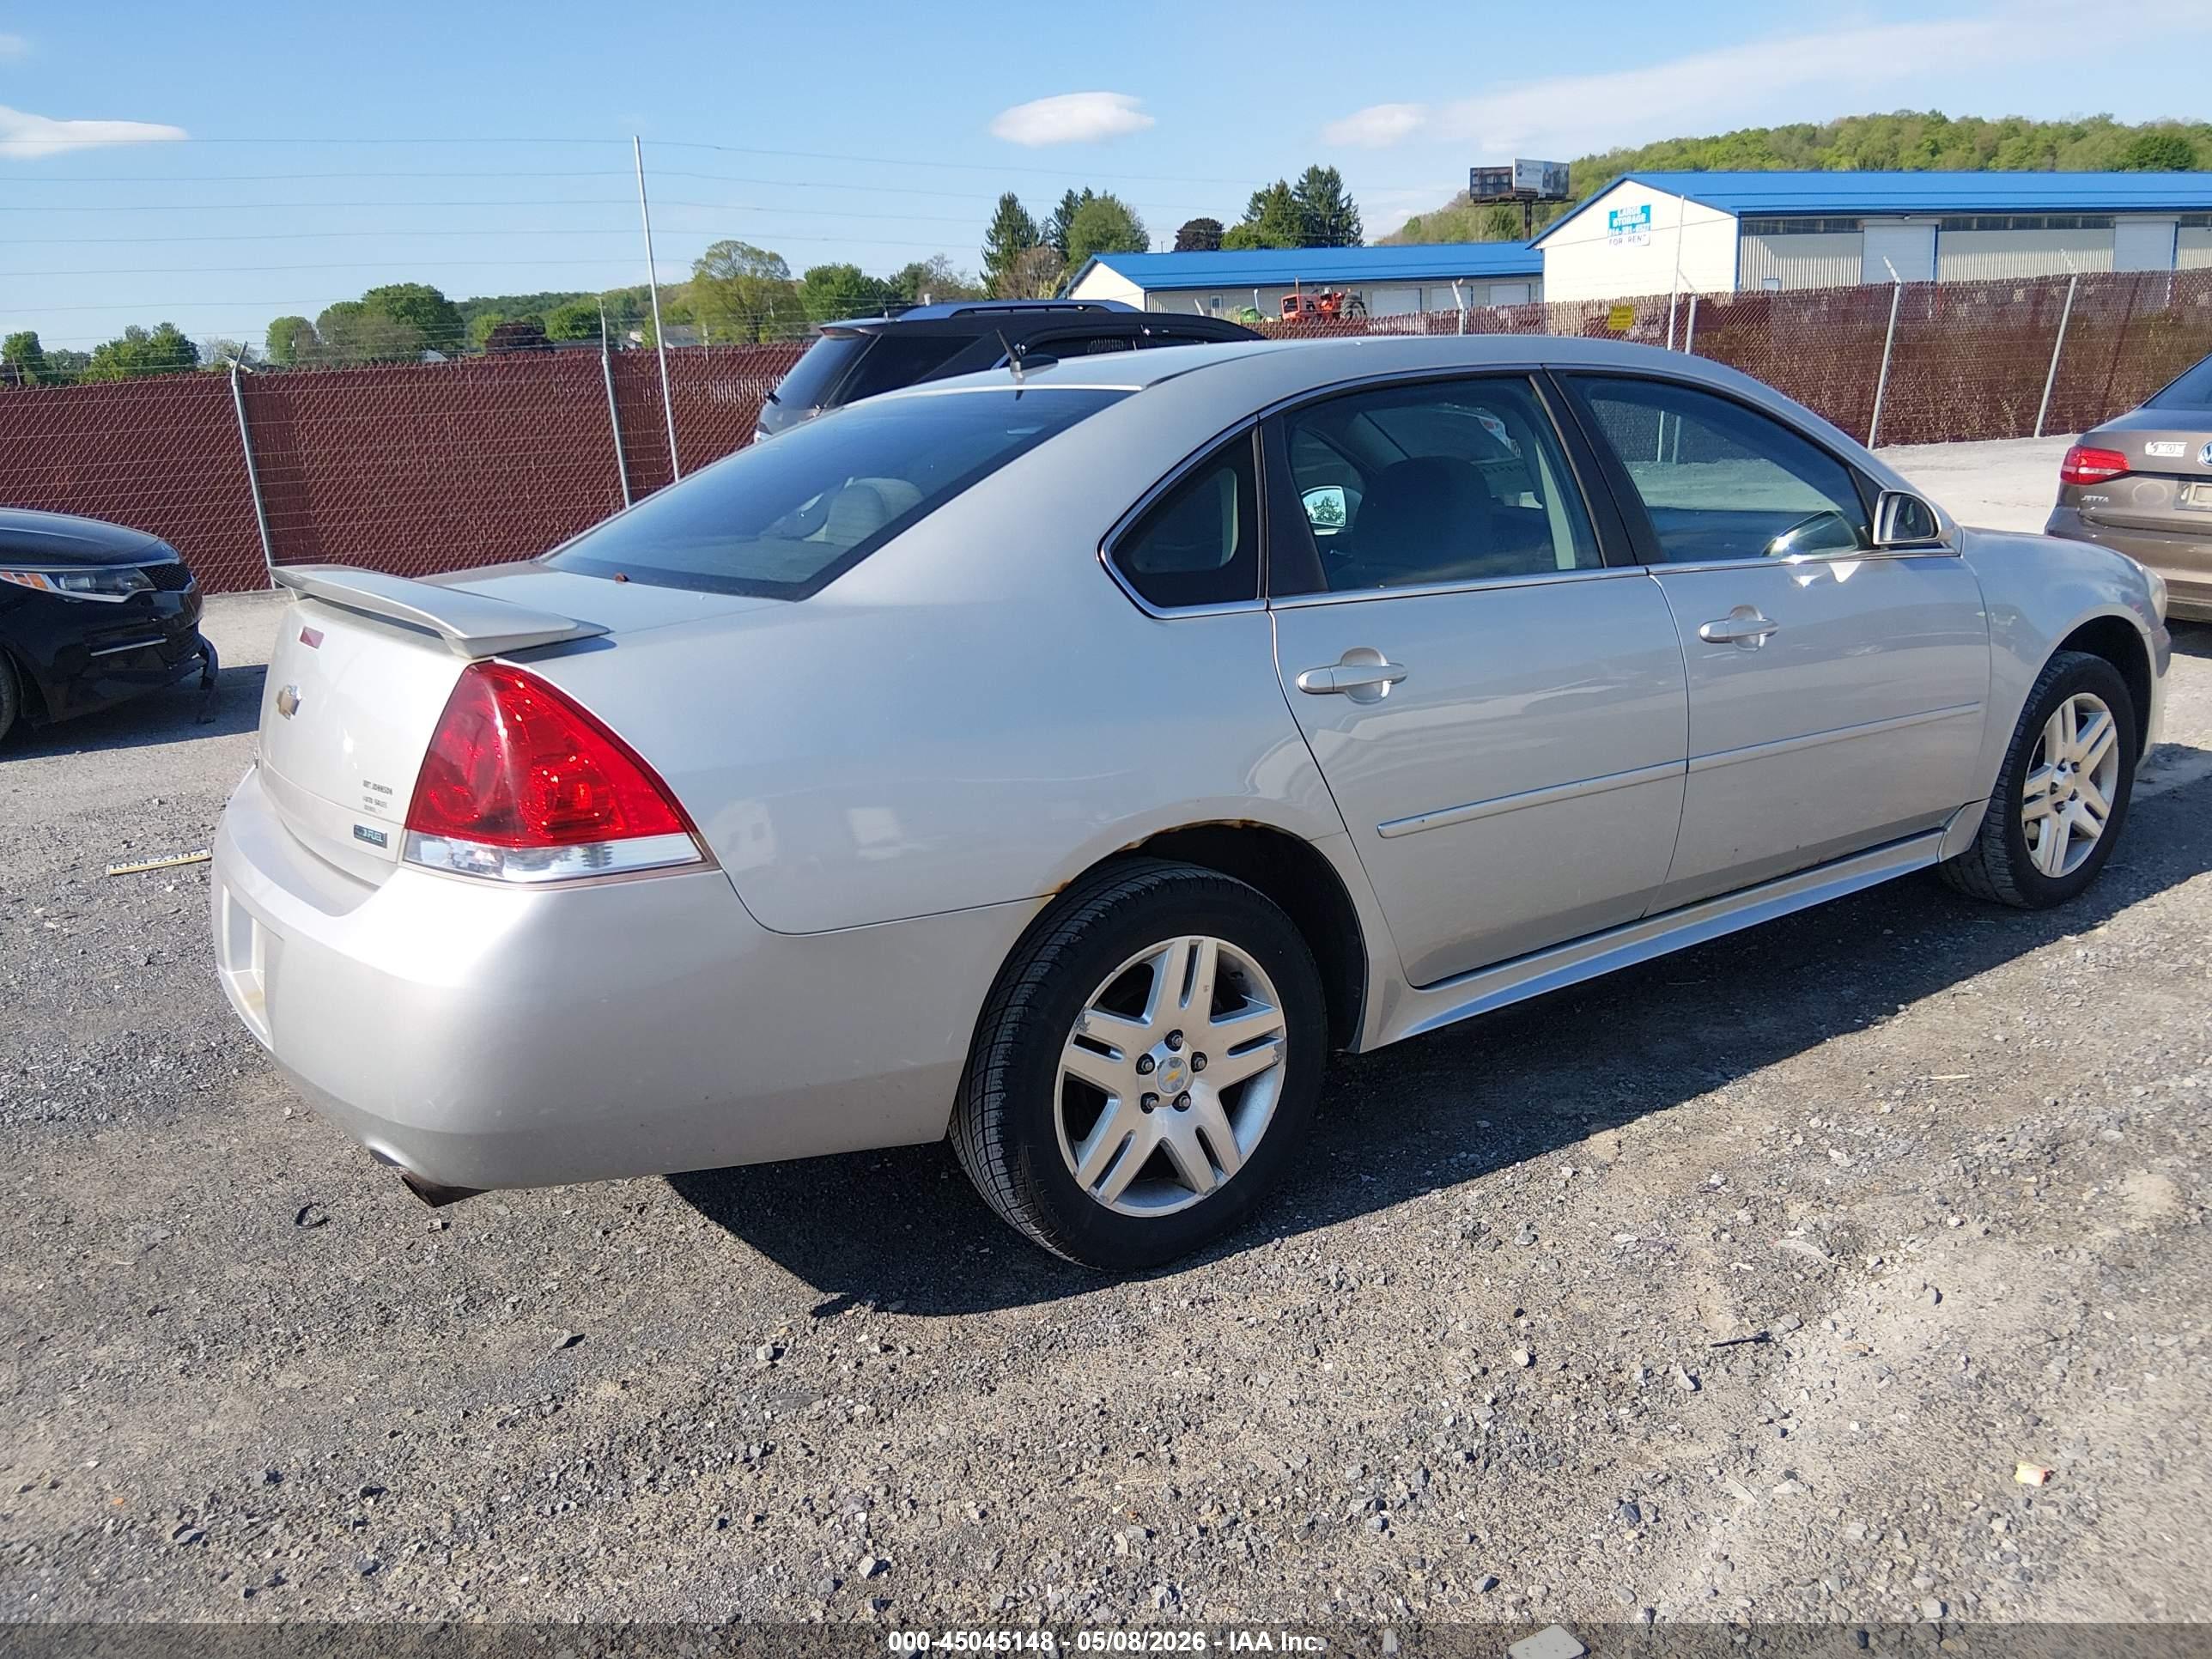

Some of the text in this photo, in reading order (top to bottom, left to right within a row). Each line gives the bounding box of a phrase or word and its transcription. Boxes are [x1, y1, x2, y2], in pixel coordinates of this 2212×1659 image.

[1608, 234, 1647, 246] FOR RENT
[2081, 495, 2110, 503] JETTA
